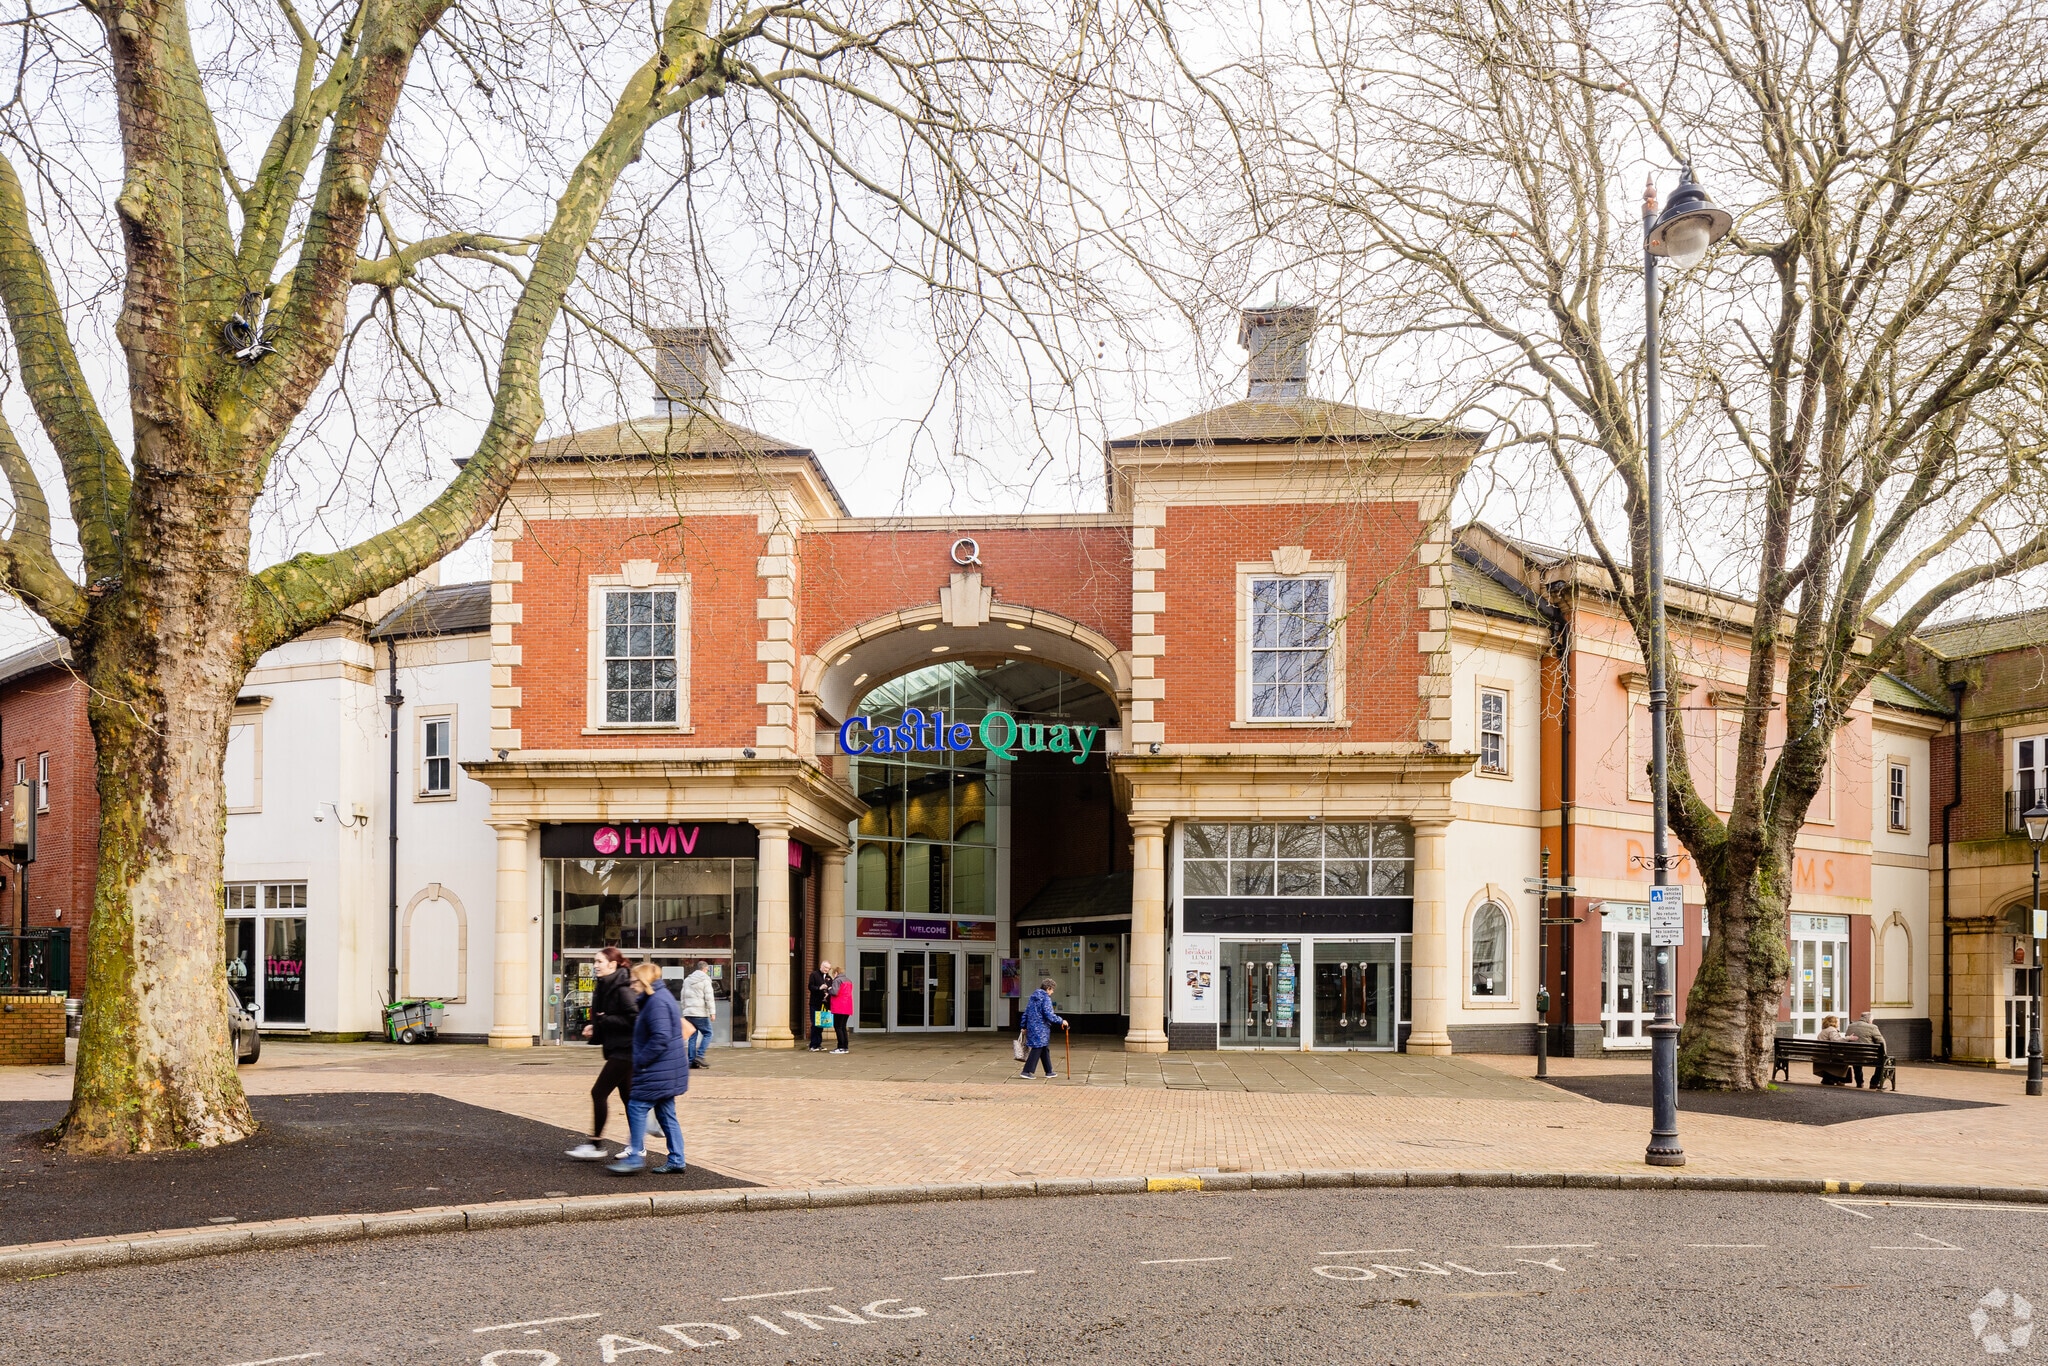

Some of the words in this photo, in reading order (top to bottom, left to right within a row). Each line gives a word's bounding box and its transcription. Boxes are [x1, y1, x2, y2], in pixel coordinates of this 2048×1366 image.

[838, 707, 973, 756] Castle
[979, 711, 1099, 765] Quay
[624, 826, 700, 855] HMV
[910, 926, 946, 934] WELCOME
[1027, 925, 1073, 936] DEBENHAMS
[267, 955, 303, 975] hmv
[1312, 1259, 1567, 1280] ONLY
[480, 1298, 928, 1366] OADING
